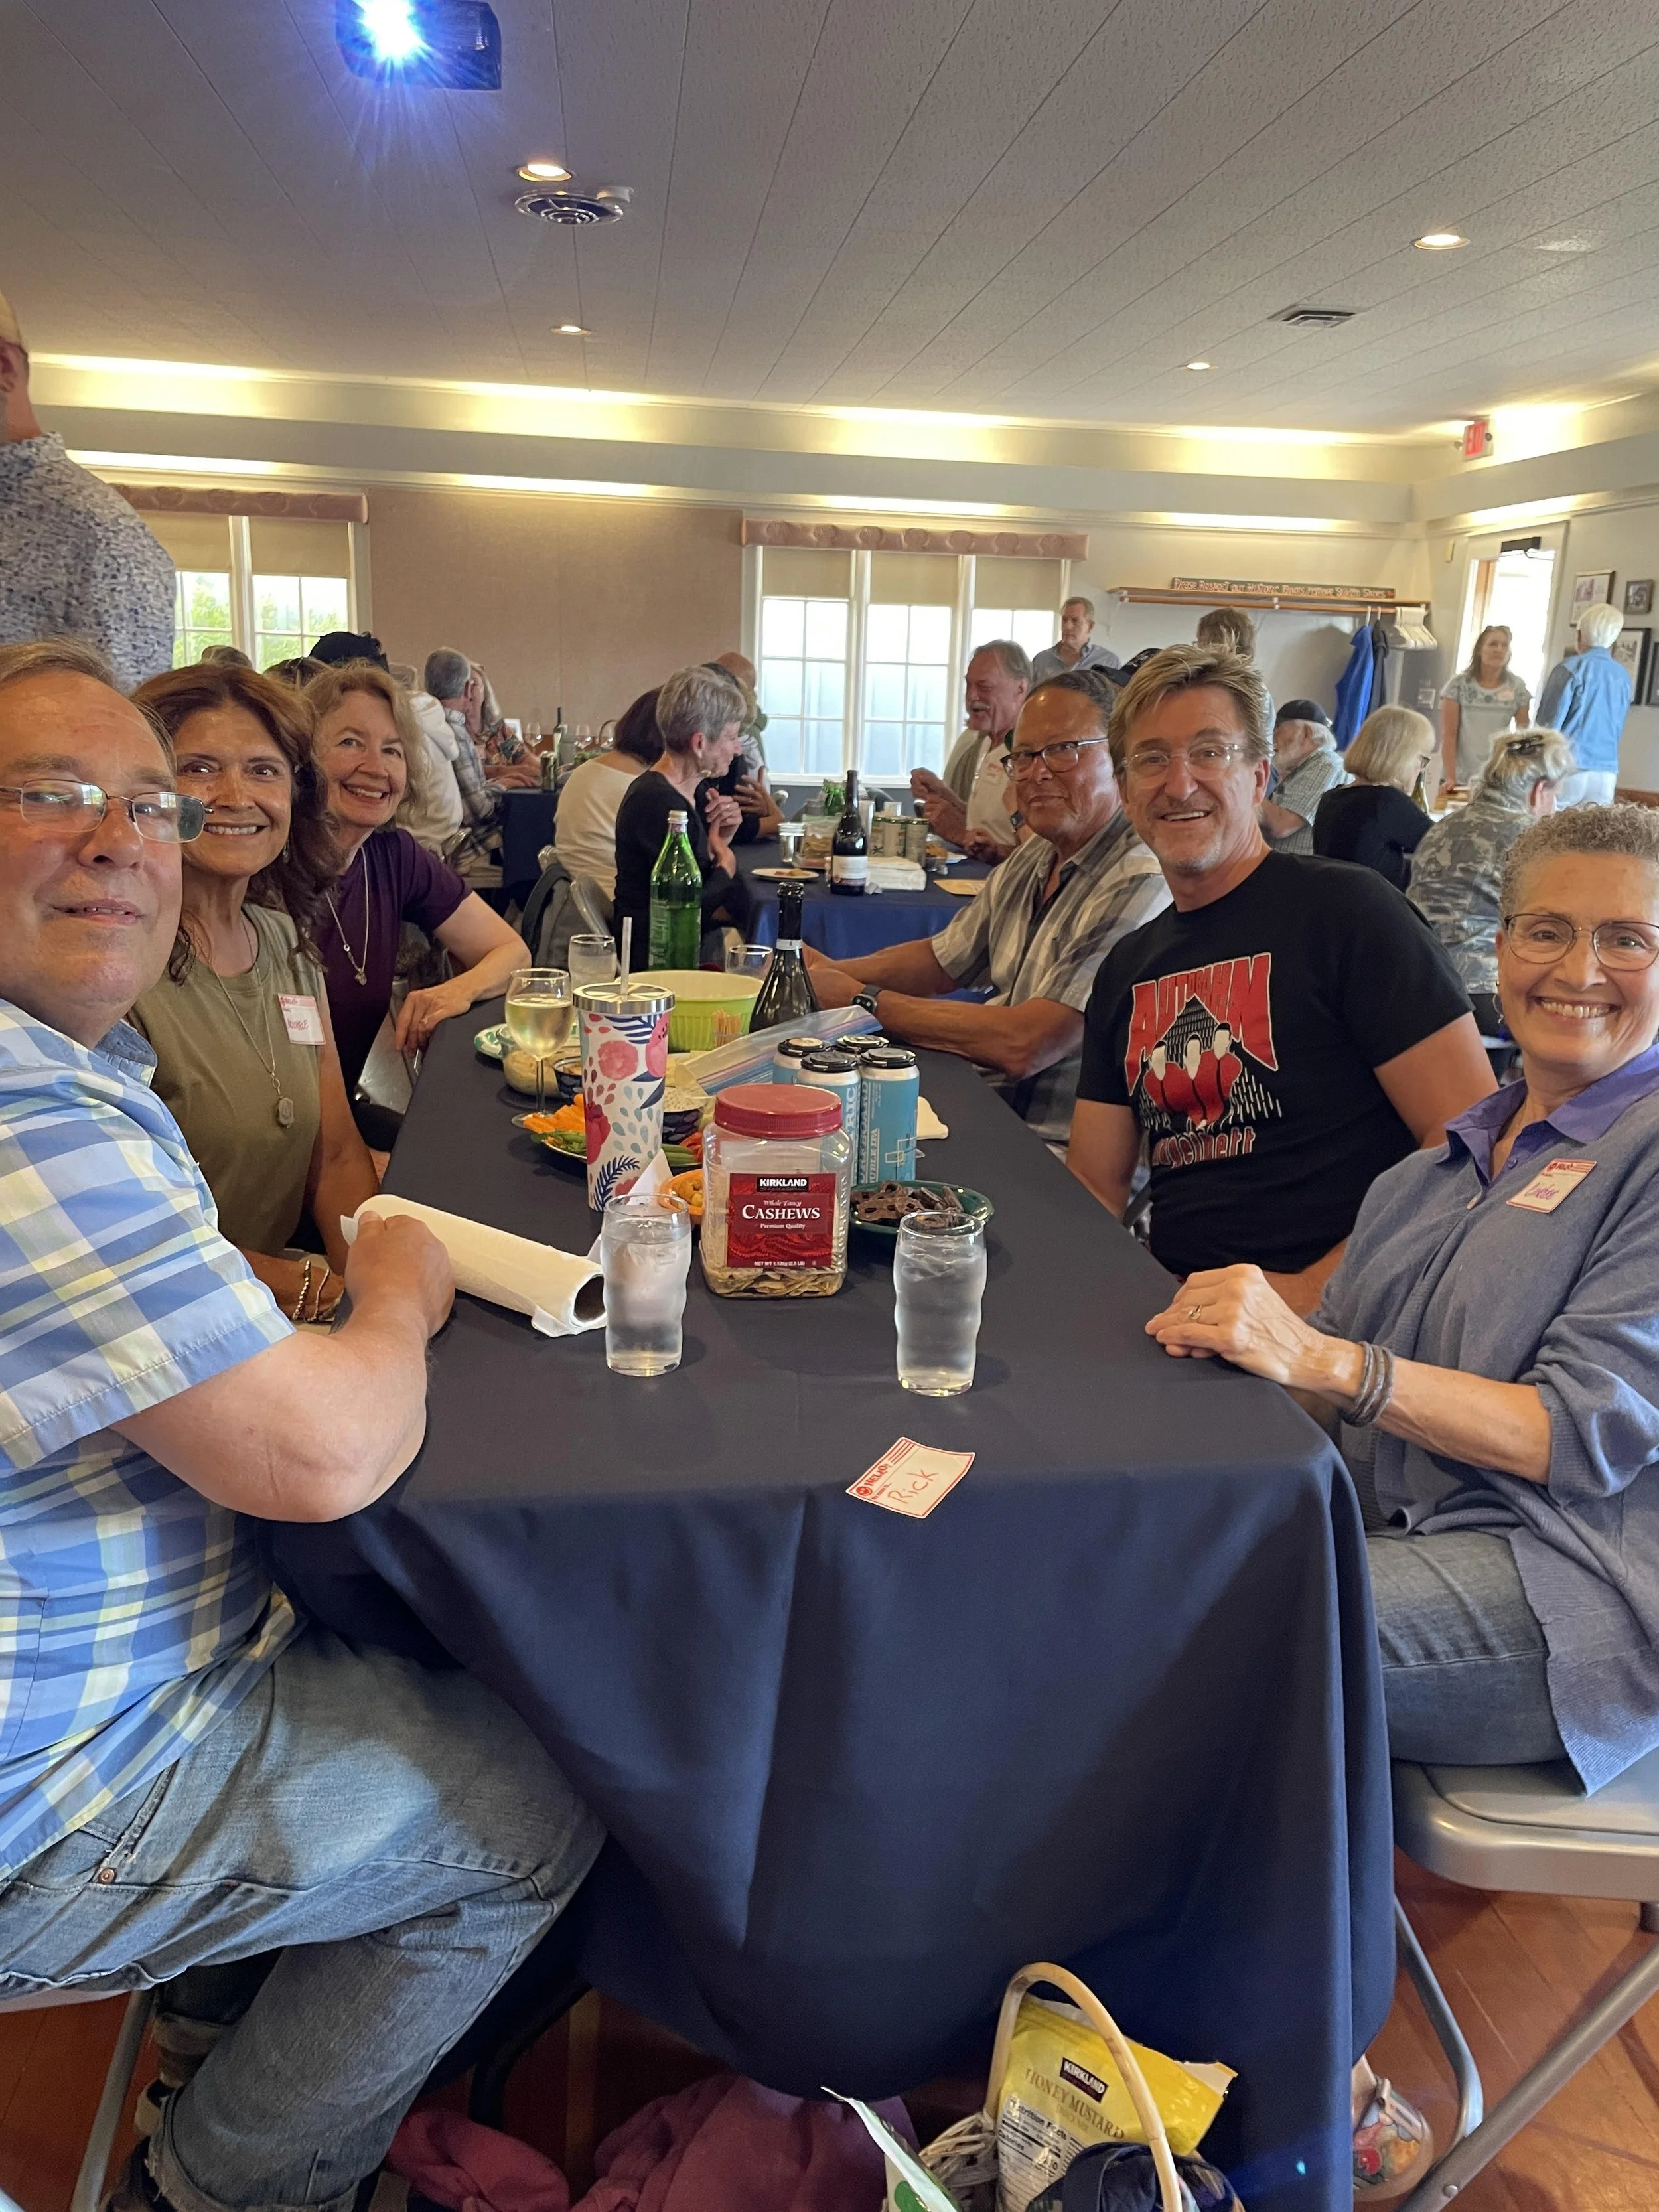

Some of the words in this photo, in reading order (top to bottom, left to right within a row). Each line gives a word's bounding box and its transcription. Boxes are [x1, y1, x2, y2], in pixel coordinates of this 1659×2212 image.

[887, 1469, 939, 1504] Rick
[1064, 2061, 1106, 2094] KIRKLAND
[1025, 2068, 1070, 2104] HONEY
[1069, 2095, 1125, 2139] MUSTARD
